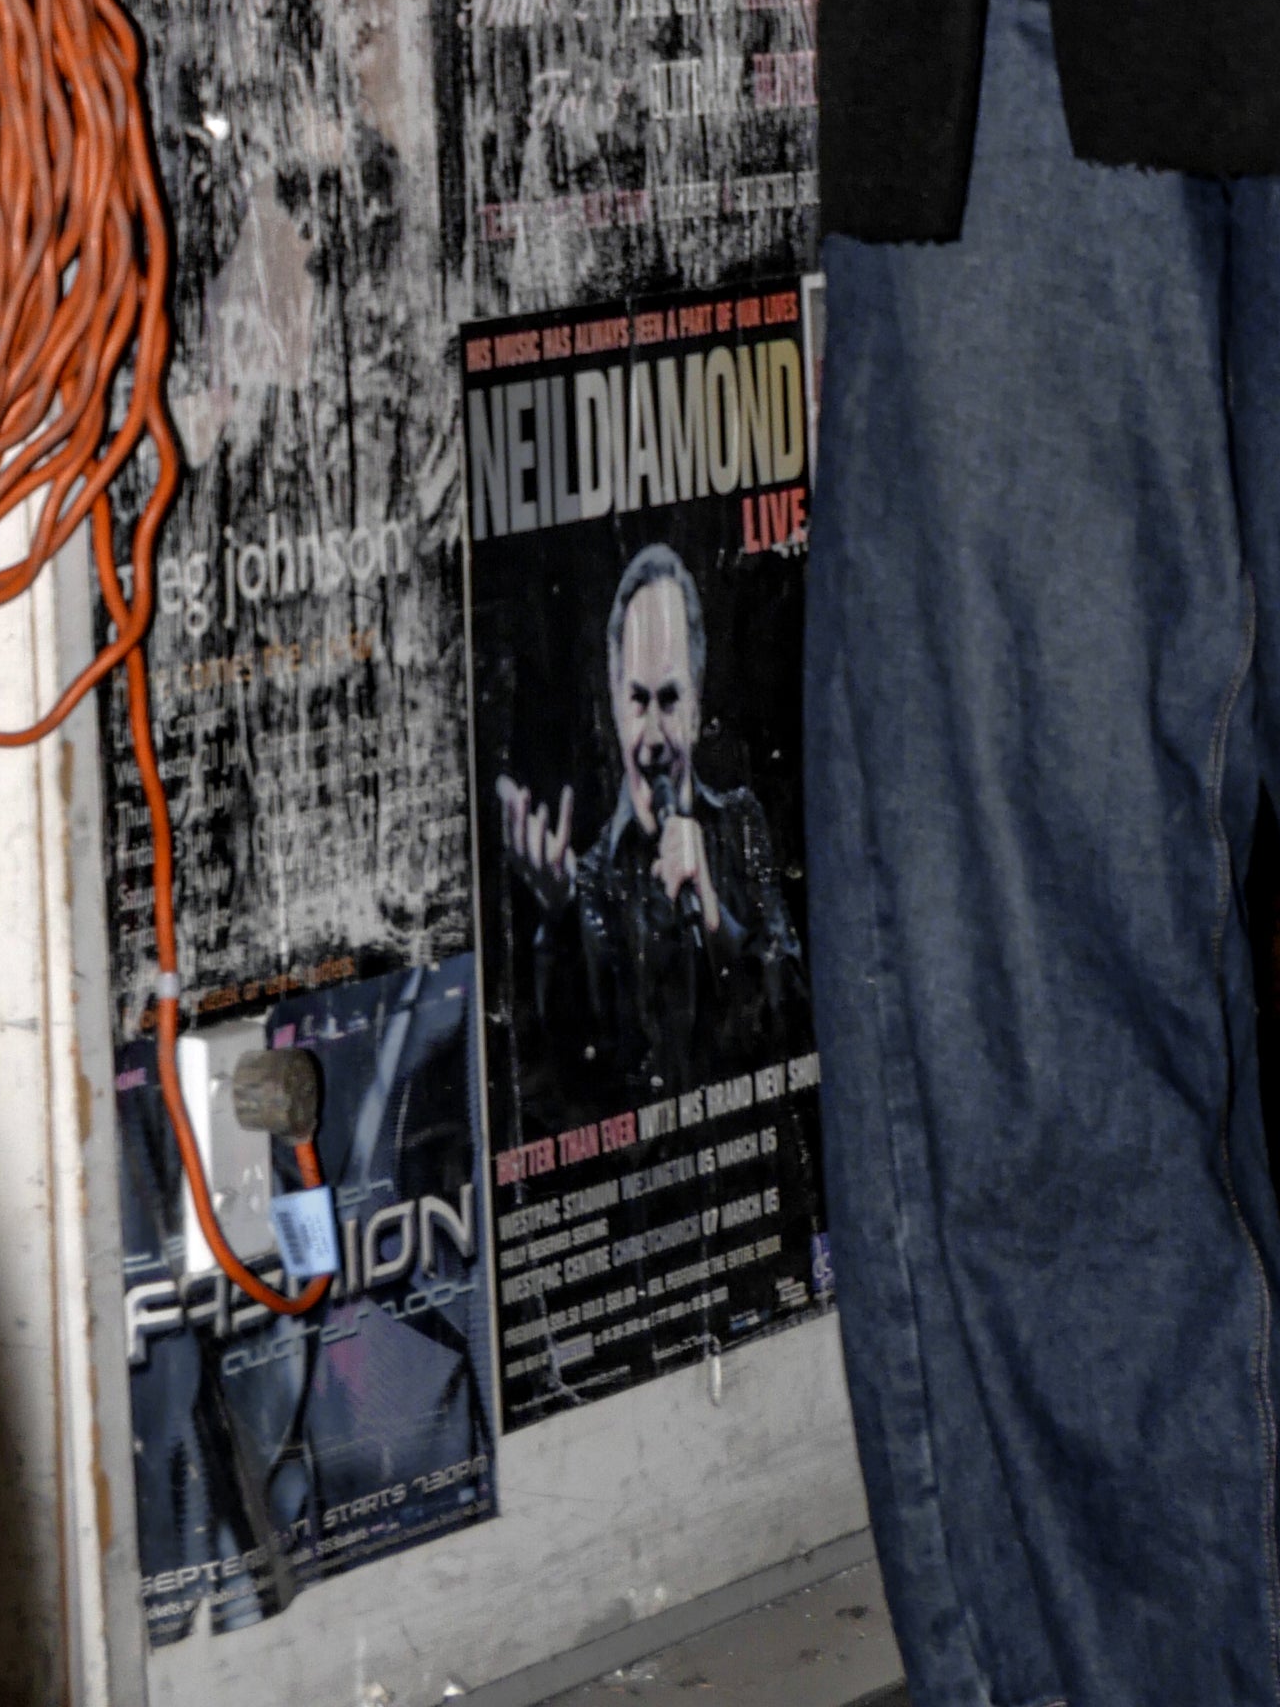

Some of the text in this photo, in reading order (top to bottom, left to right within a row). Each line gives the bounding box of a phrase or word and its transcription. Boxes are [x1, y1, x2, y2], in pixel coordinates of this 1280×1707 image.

[465, 338, 492, 372] HIS
[494, 330, 541, 369] MUSIC
[542, 326, 572, 362] HAS
[574, 317, 630, 355] ALWAYS
[632, 311, 665, 345] BEEN
[679, 303, 714, 336] PART
[715, 301, 733, 331] OF
[763, 291, 799, 325] LIVES
[468, 338, 805, 541] NEIL DIAMOND
[222, 511, 406, 630] johnson
[742, 487, 807, 555] LIVE
[124, 1184, 474, 1366] FASION
[322, 1484, 407, 1530] STARTS
